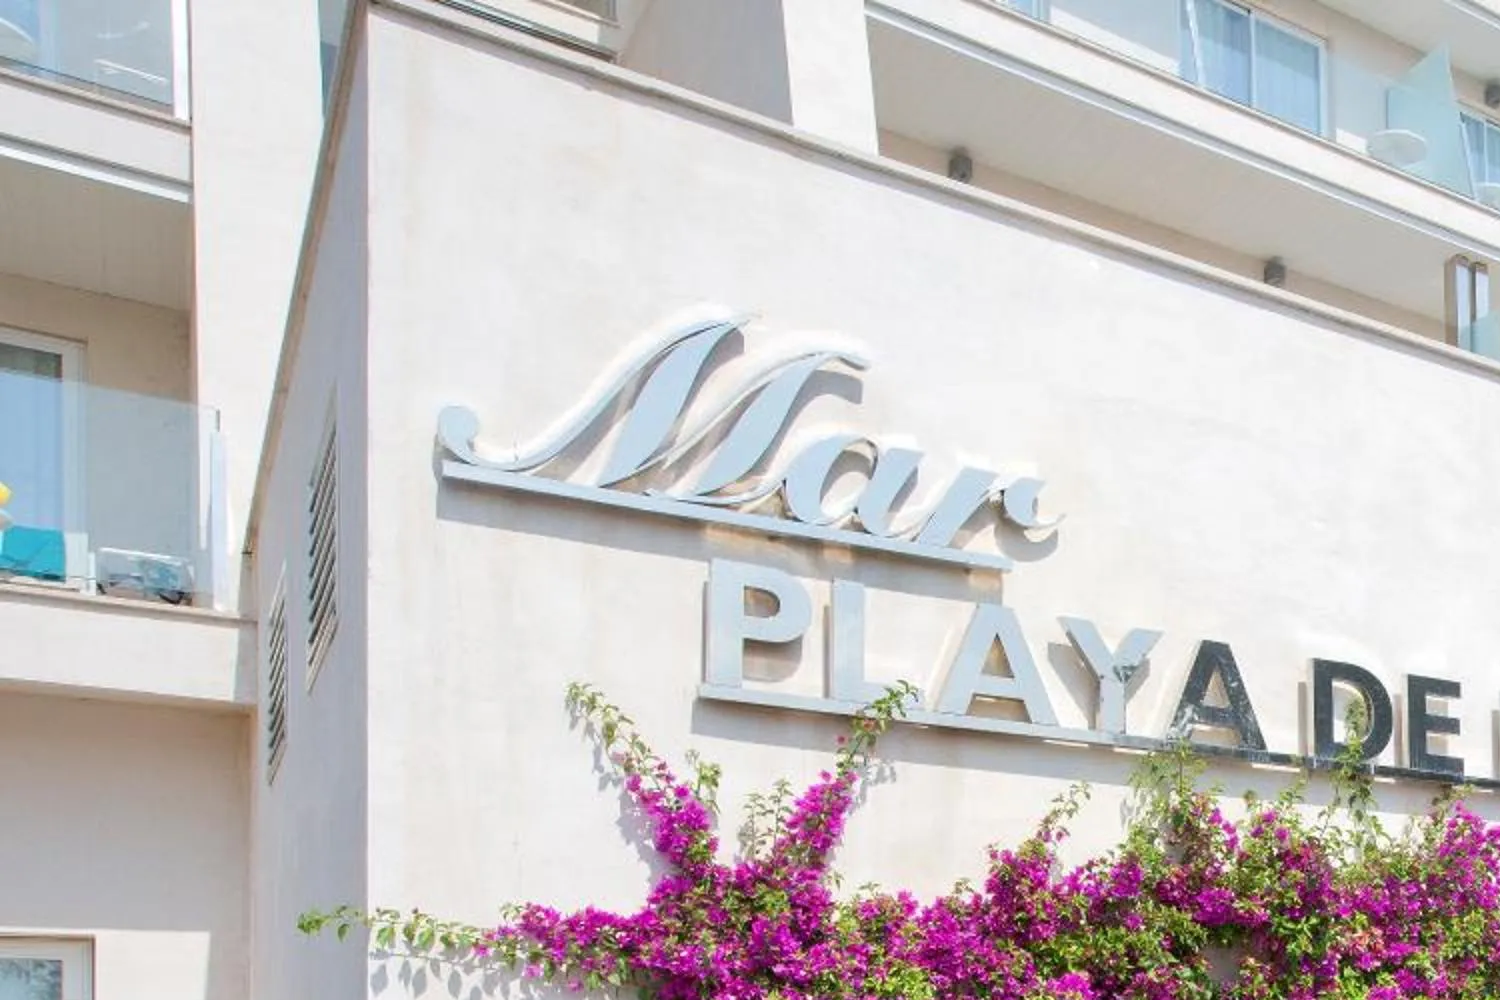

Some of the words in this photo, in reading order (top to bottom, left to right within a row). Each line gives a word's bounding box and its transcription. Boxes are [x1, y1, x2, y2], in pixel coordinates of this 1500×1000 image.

[437, 312, 1066, 548] Mar
[708, 560, 1266, 752] PLAYA
[1312, 658, 1463, 780] DE
